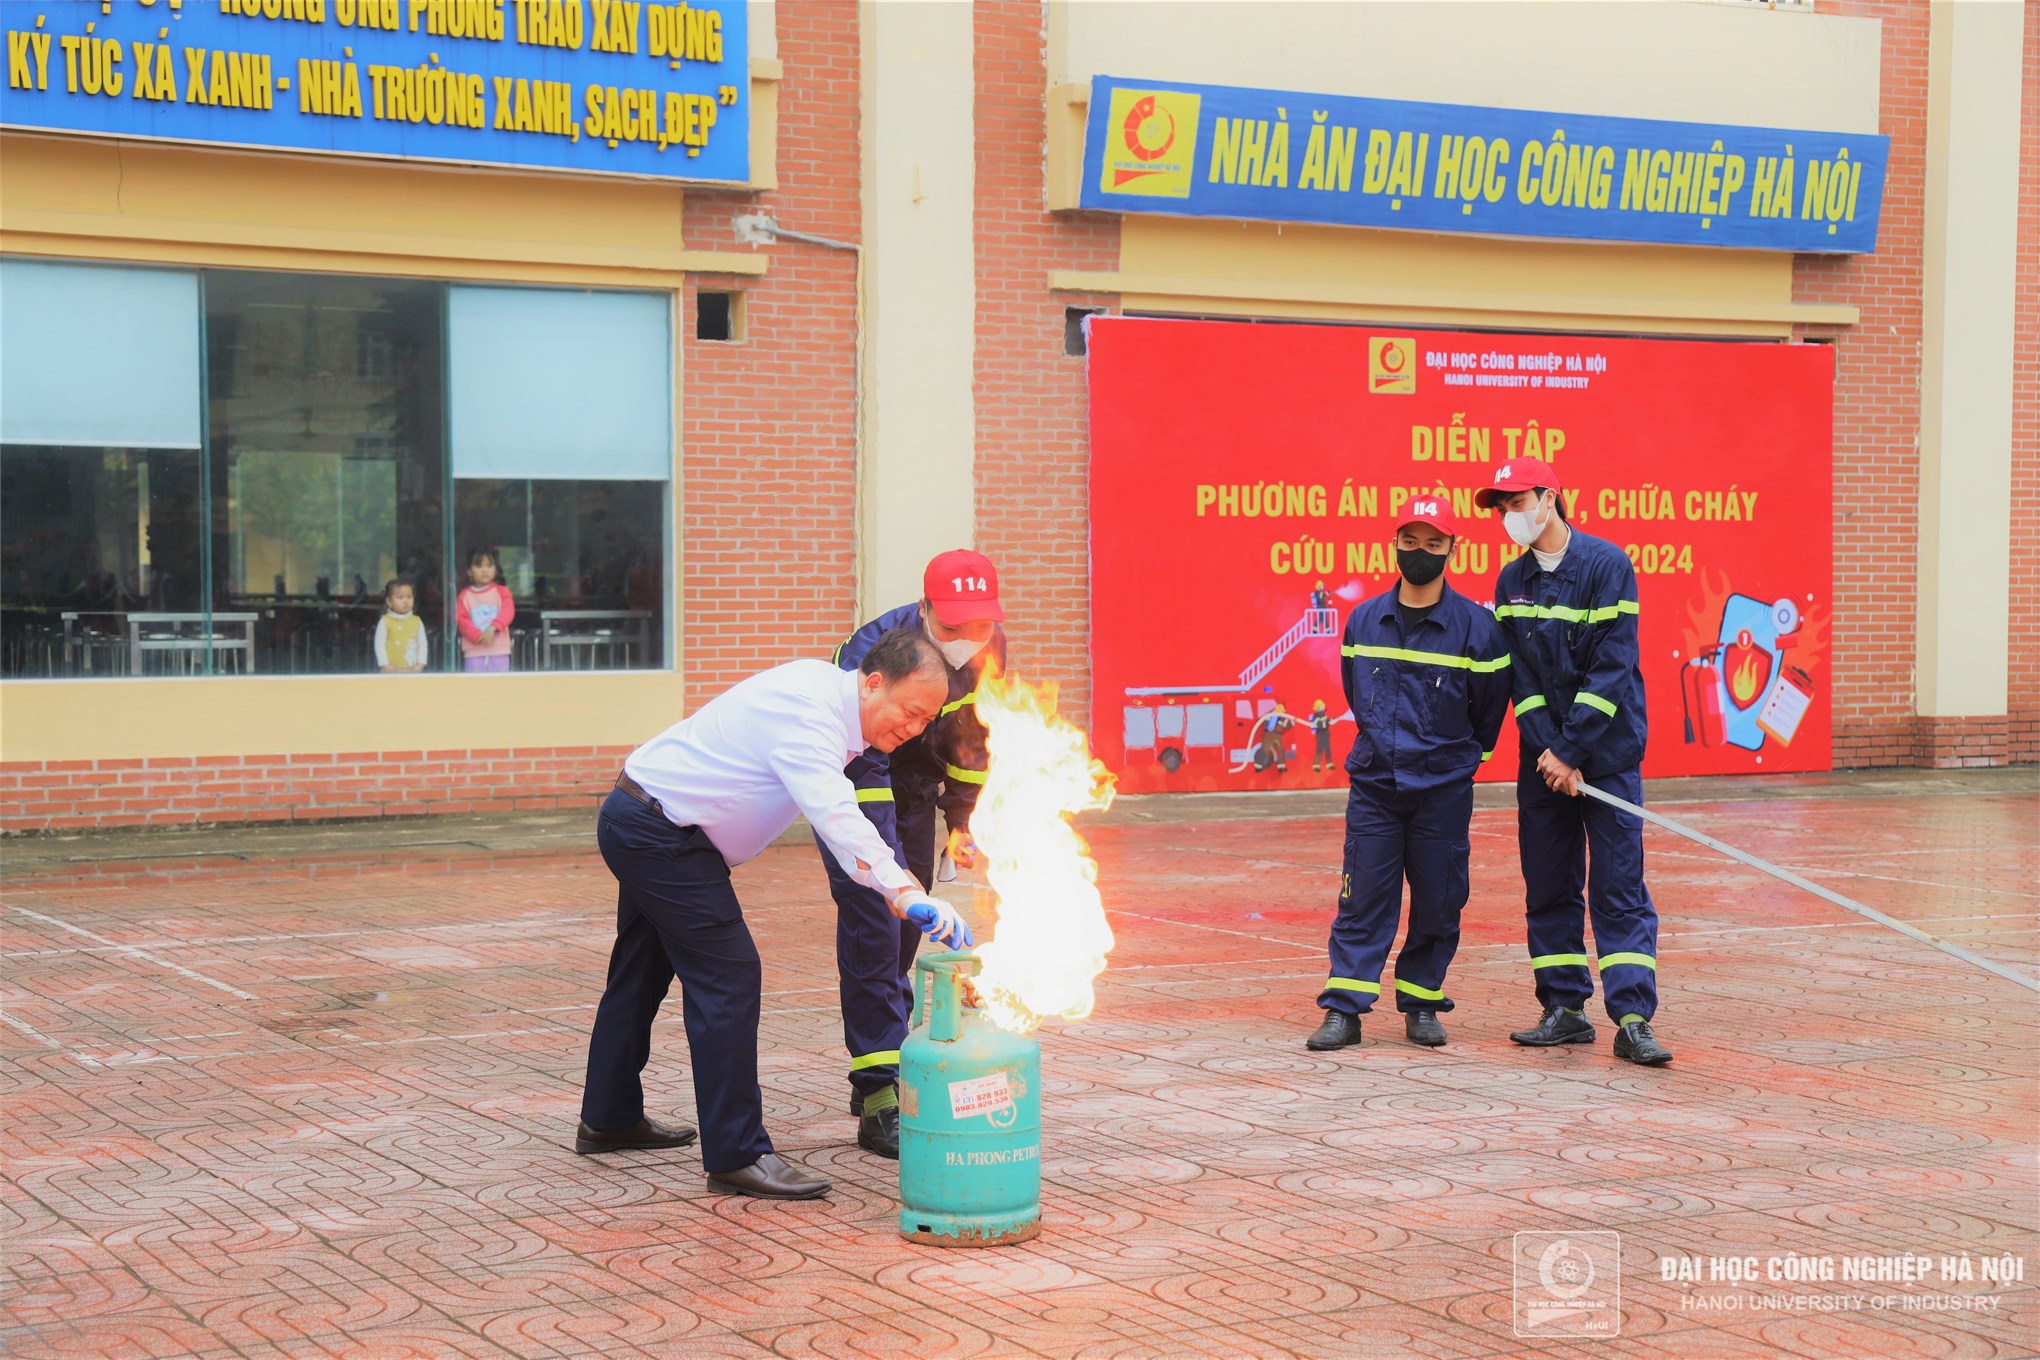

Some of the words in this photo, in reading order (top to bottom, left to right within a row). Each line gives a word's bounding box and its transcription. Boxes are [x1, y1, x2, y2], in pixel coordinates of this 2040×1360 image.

[648, 1, 724, 70] DỰNG
[7, 15, 51, 90] KÝ
[60, 22, 123, 96] TÚC
[132, 27, 177, 101] XÁ
[184, 47, 273, 110] XANH
[297, 46, 363, 118] NHÀ
[368, 53, 485, 128] TRƯỜNG
[493, 76, 579, 143] XANH,
[1208, 107, 1289, 188] NHÀ
[1298, 110, 1358, 192] ĂN
[1362, 129, 1430, 210] ĐẠI
[1434, 134, 1510, 215] HỌC
[1517, 129, 1615, 210] CÔNG
[1619, 140, 1746, 229] NGHIỆP
[1749, 144, 1795, 219] HÀ
[1801, 147, 1862, 235] NỘI
[1425, 351, 1448, 370] ĐẠI
[1451, 352, 1477, 371] HỌC
[1480, 350, 1515, 370] CÔNG
[1518, 352, 1563, 373] NGHIỆP
[1566, 353, 1583, 371] HÀ
[1585, 353, 1607, 375] NỘI
[1444, 373, 1474, 386] HANOI
[1475, 374, 1529, 387] UNIVERSITY
[1530, 376, 1543, 388] OF
[1545, 376, 1589, 389] INDUSTRY
[1411, 412, 1490, 462] DIỄN
[1196, 481, 1327, 517] PHƯƠNG
[1337, 478, 1378, 517] ÁN
[1598, 483, 1676, 521] CHỮA
[1685, 484, 1758, 522] CHÁY
[1414, 502, 1438, 516] 114
[1270, 535, 1335, 575] CỨU
[1626, 544, 1693, 574] 2024
[952, 577, 987, 593] 114
[967, 1150, 1012, 1166] PHONG
